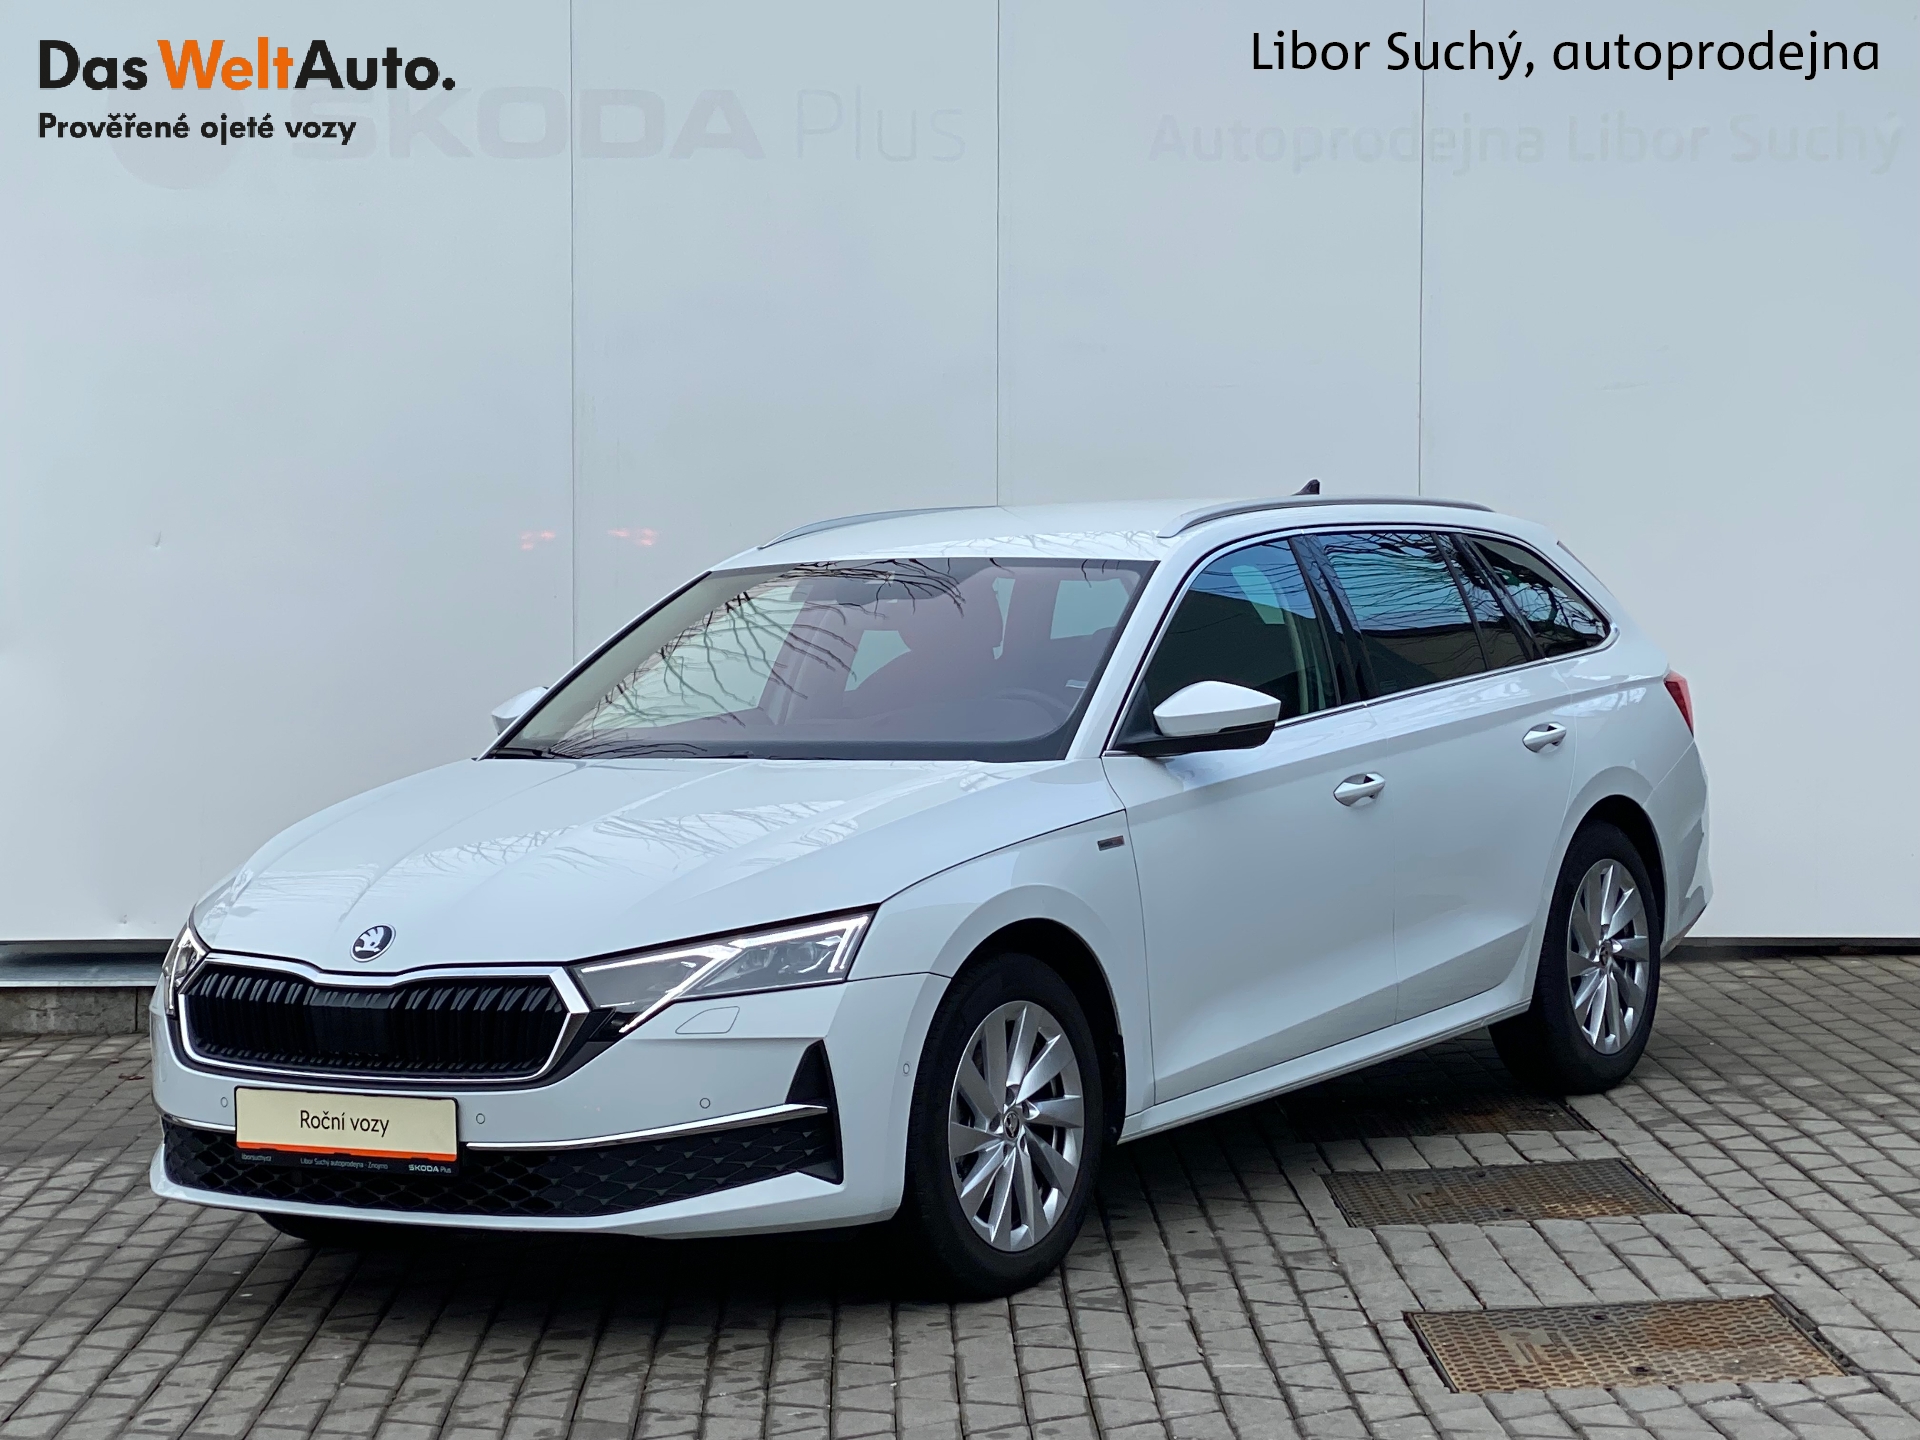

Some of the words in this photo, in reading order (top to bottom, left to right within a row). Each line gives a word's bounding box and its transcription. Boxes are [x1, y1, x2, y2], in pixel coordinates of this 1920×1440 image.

[795, 83, 966, 162] Plus
[1147, 112, 1545, 176] Autoprodejna
[1567, 112, 1711, 163] Libor
[1728, 110, 1904, 175] Suchý
[299, 1109, 345, 1131] Roční
[349, 1116, 390, 1138] vozy
